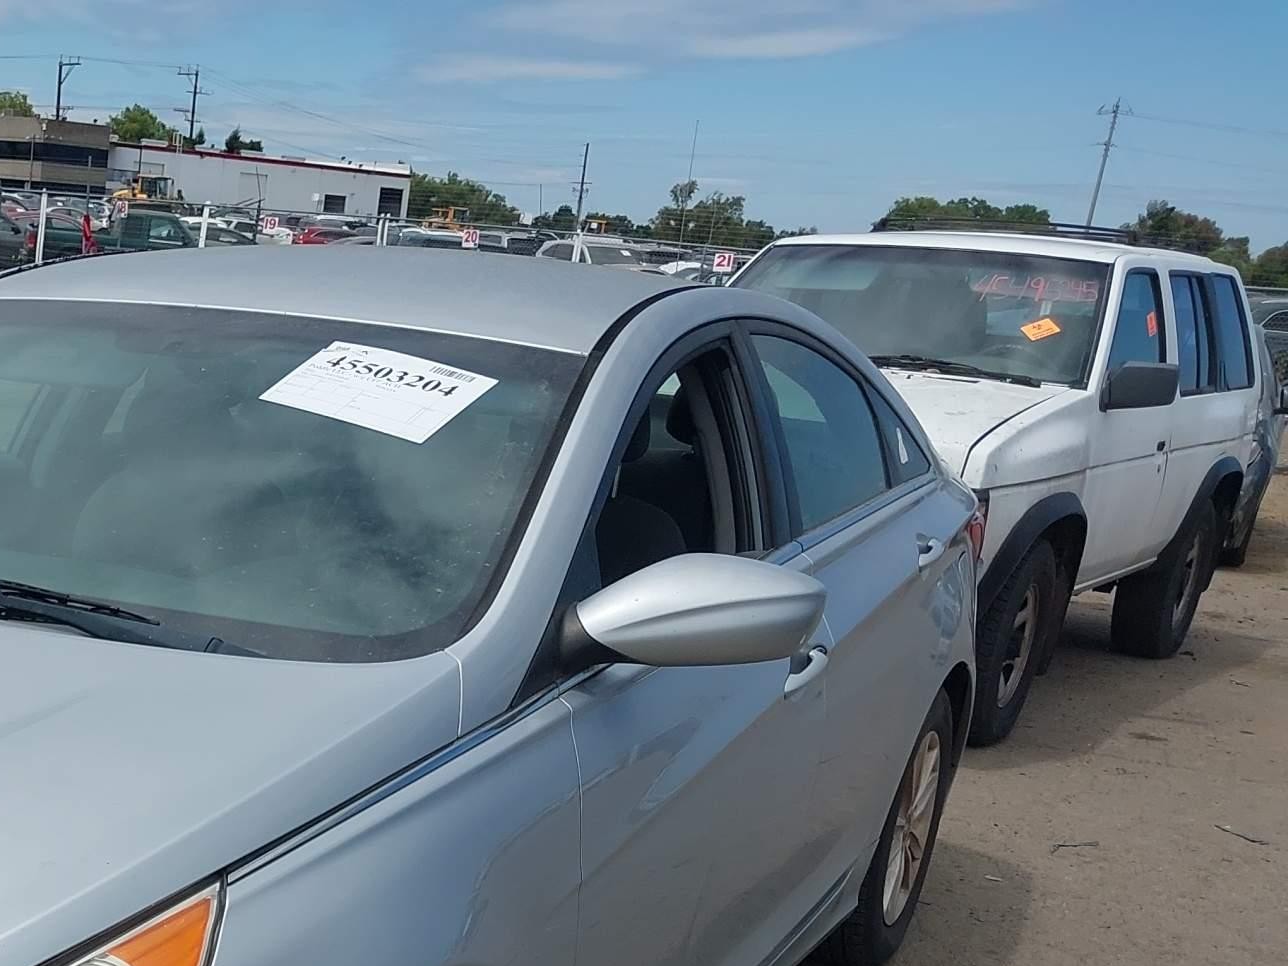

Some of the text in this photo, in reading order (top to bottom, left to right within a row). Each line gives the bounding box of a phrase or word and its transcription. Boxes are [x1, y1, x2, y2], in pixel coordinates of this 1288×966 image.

[264, 218, 277, 230] 19
[464, 231, 477, 243] 20
[715, 255, 731, 267] 21
[327, 356, 458, 396] 45503204
